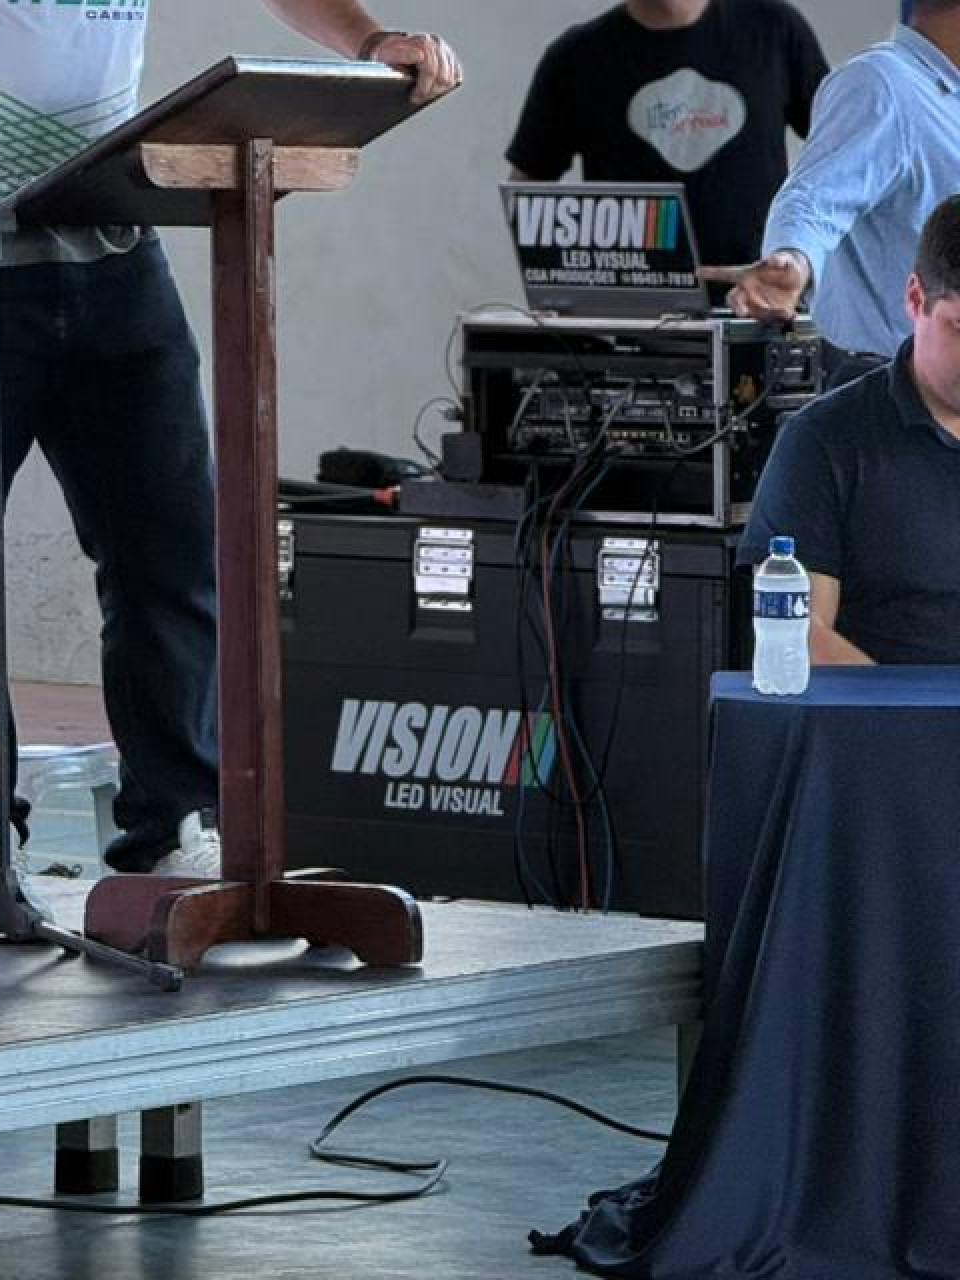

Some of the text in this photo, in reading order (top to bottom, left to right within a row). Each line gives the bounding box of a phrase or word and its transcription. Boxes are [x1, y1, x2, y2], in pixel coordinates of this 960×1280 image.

[518, 196, 646, 249] VISION
[562, 250, 651, 271] LED VISUAL
[331, 698, 522, 784] VISION
[384, 782, 505, 817] LED VISUAL
